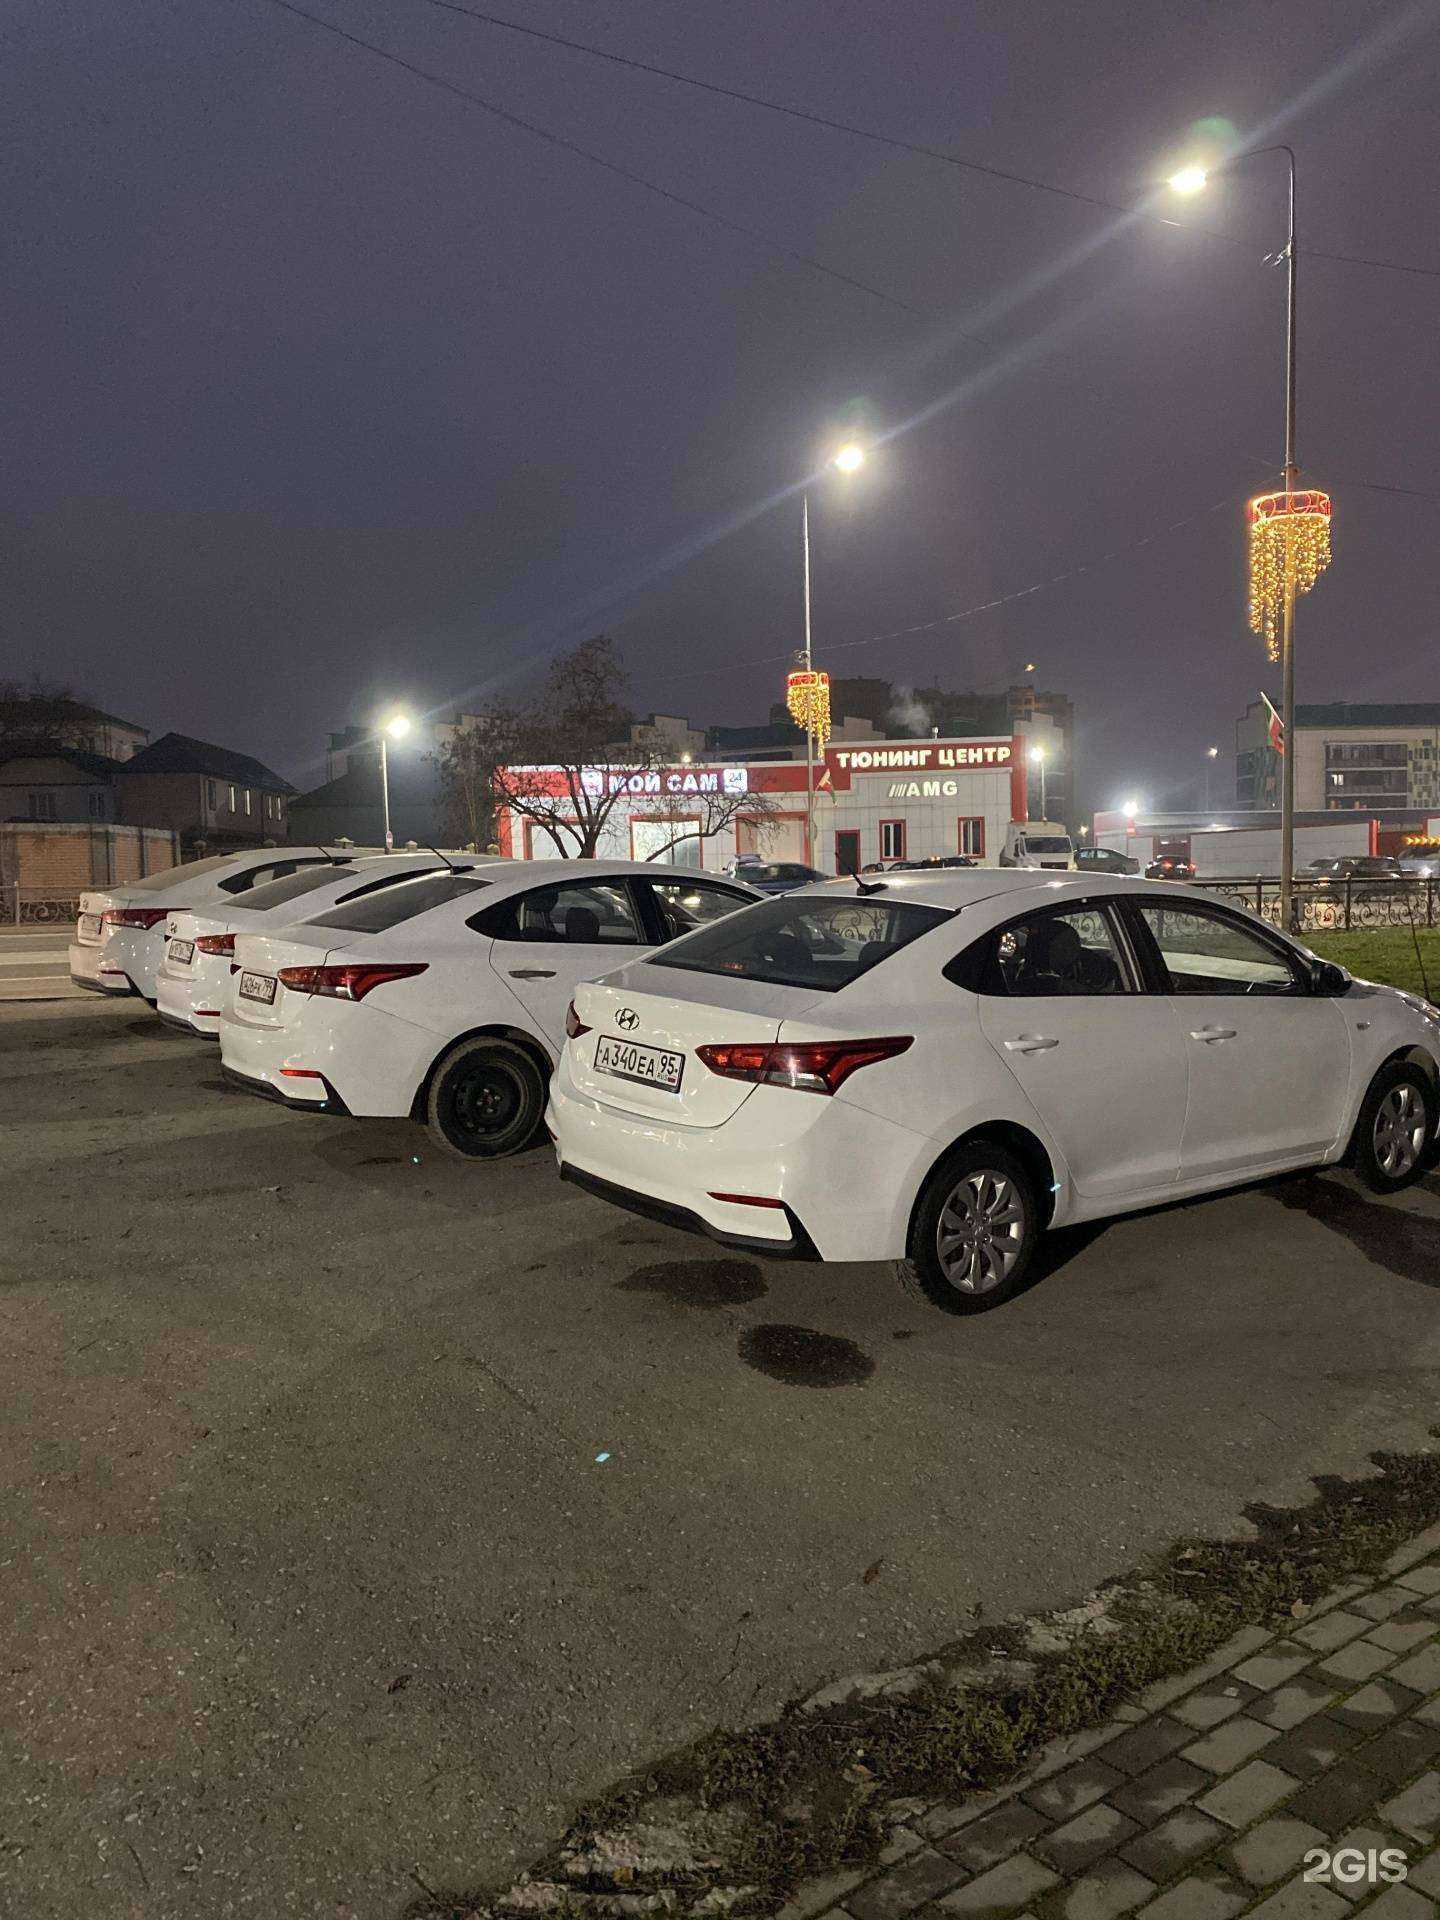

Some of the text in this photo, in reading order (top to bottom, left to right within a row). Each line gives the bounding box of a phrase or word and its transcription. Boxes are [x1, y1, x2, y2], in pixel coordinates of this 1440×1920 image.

[836, 746, 1011, 769] ТЮНИНГ ЦЕНТР
[608, 771, 718, 793] МОЙ САМ
[660, 1055, 676, 1075] 95
